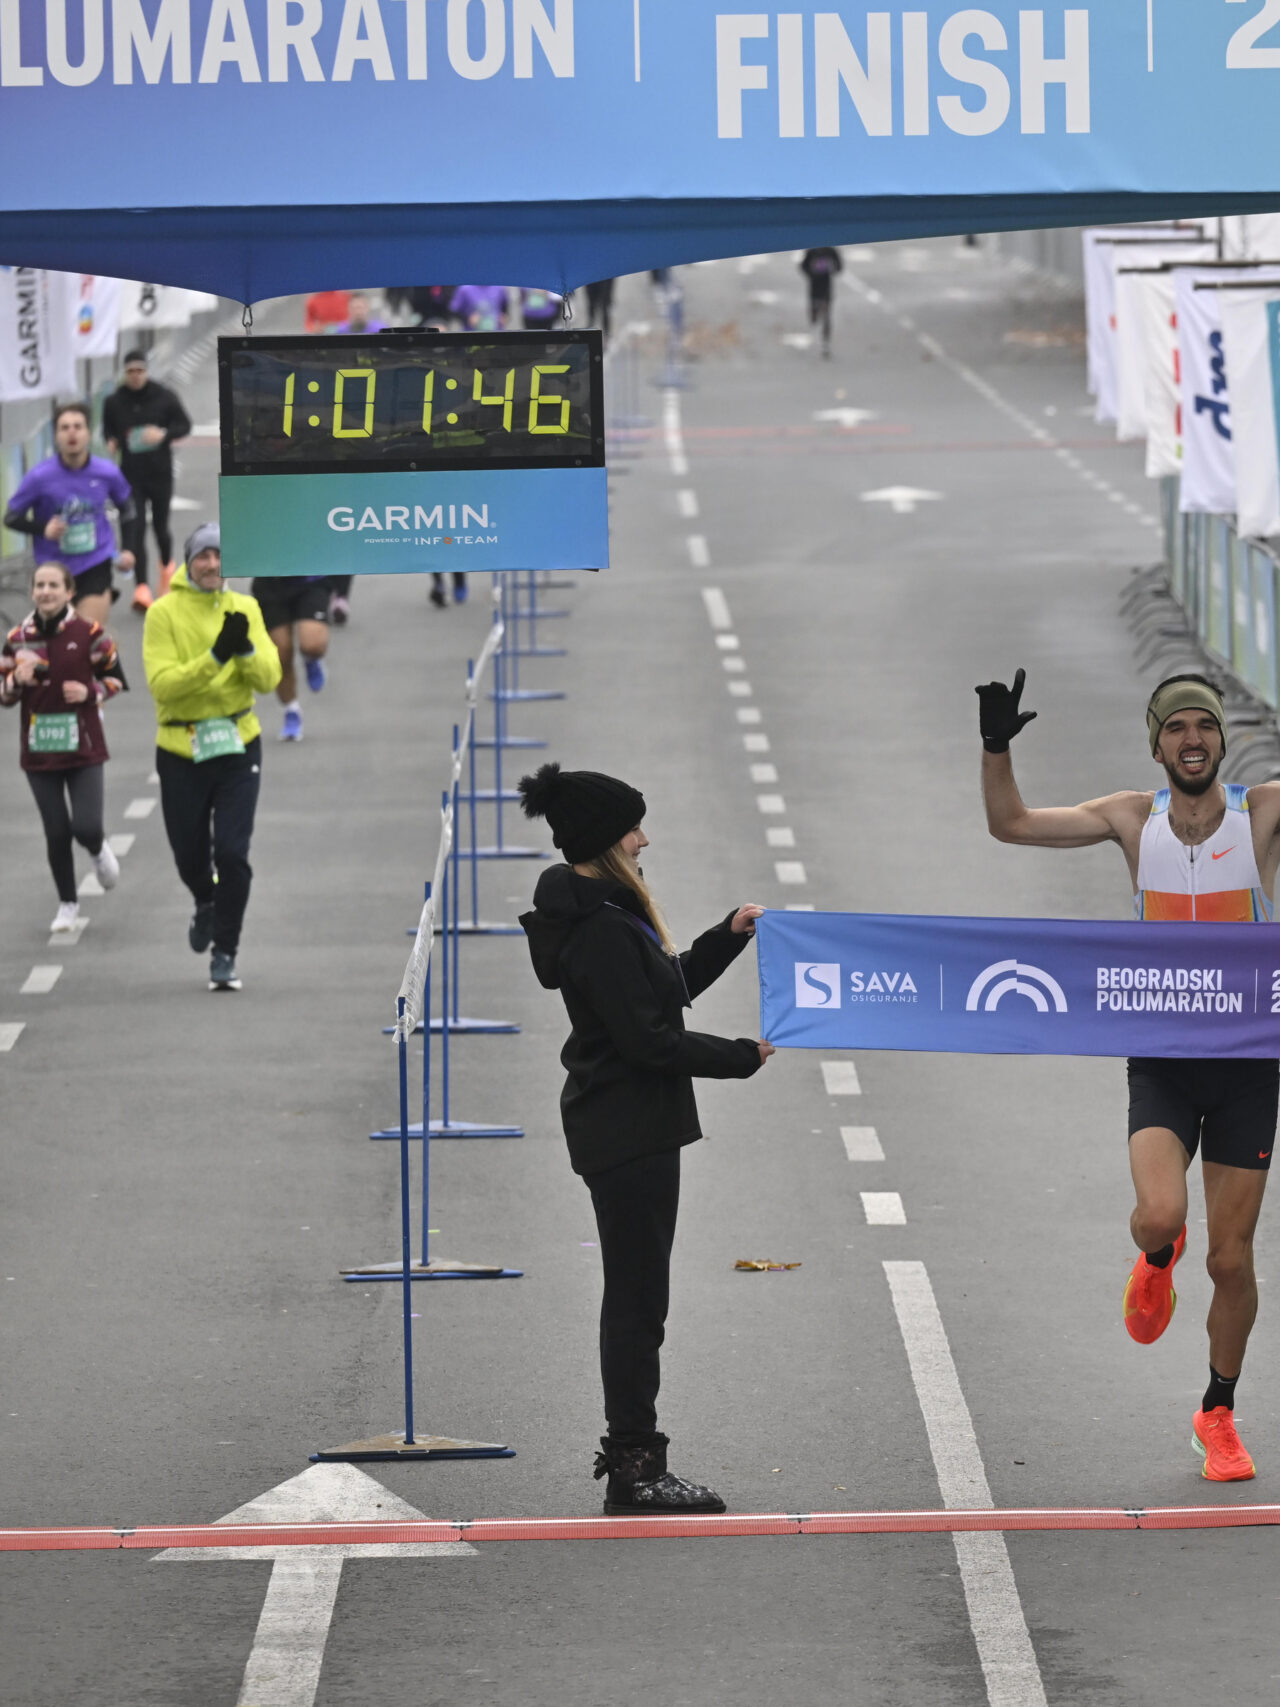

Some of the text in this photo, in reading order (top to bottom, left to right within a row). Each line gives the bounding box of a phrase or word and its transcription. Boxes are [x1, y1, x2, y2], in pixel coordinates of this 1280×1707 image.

[0, 0, 575, 87] LUMARATON
[715, 8, 1091, 139] FINISH
[281, 364, 571, 438] 1:01:46
[327, 503, 489, 532] GARMIN
[850, 971, 918, 994] SAVA
[1096, 967, 1223, 991] BEOGRADSKI
[851, 994, 919, 1003] OSIGURANJE
[1096, 991, 1243, 1013] POLUMARATON
